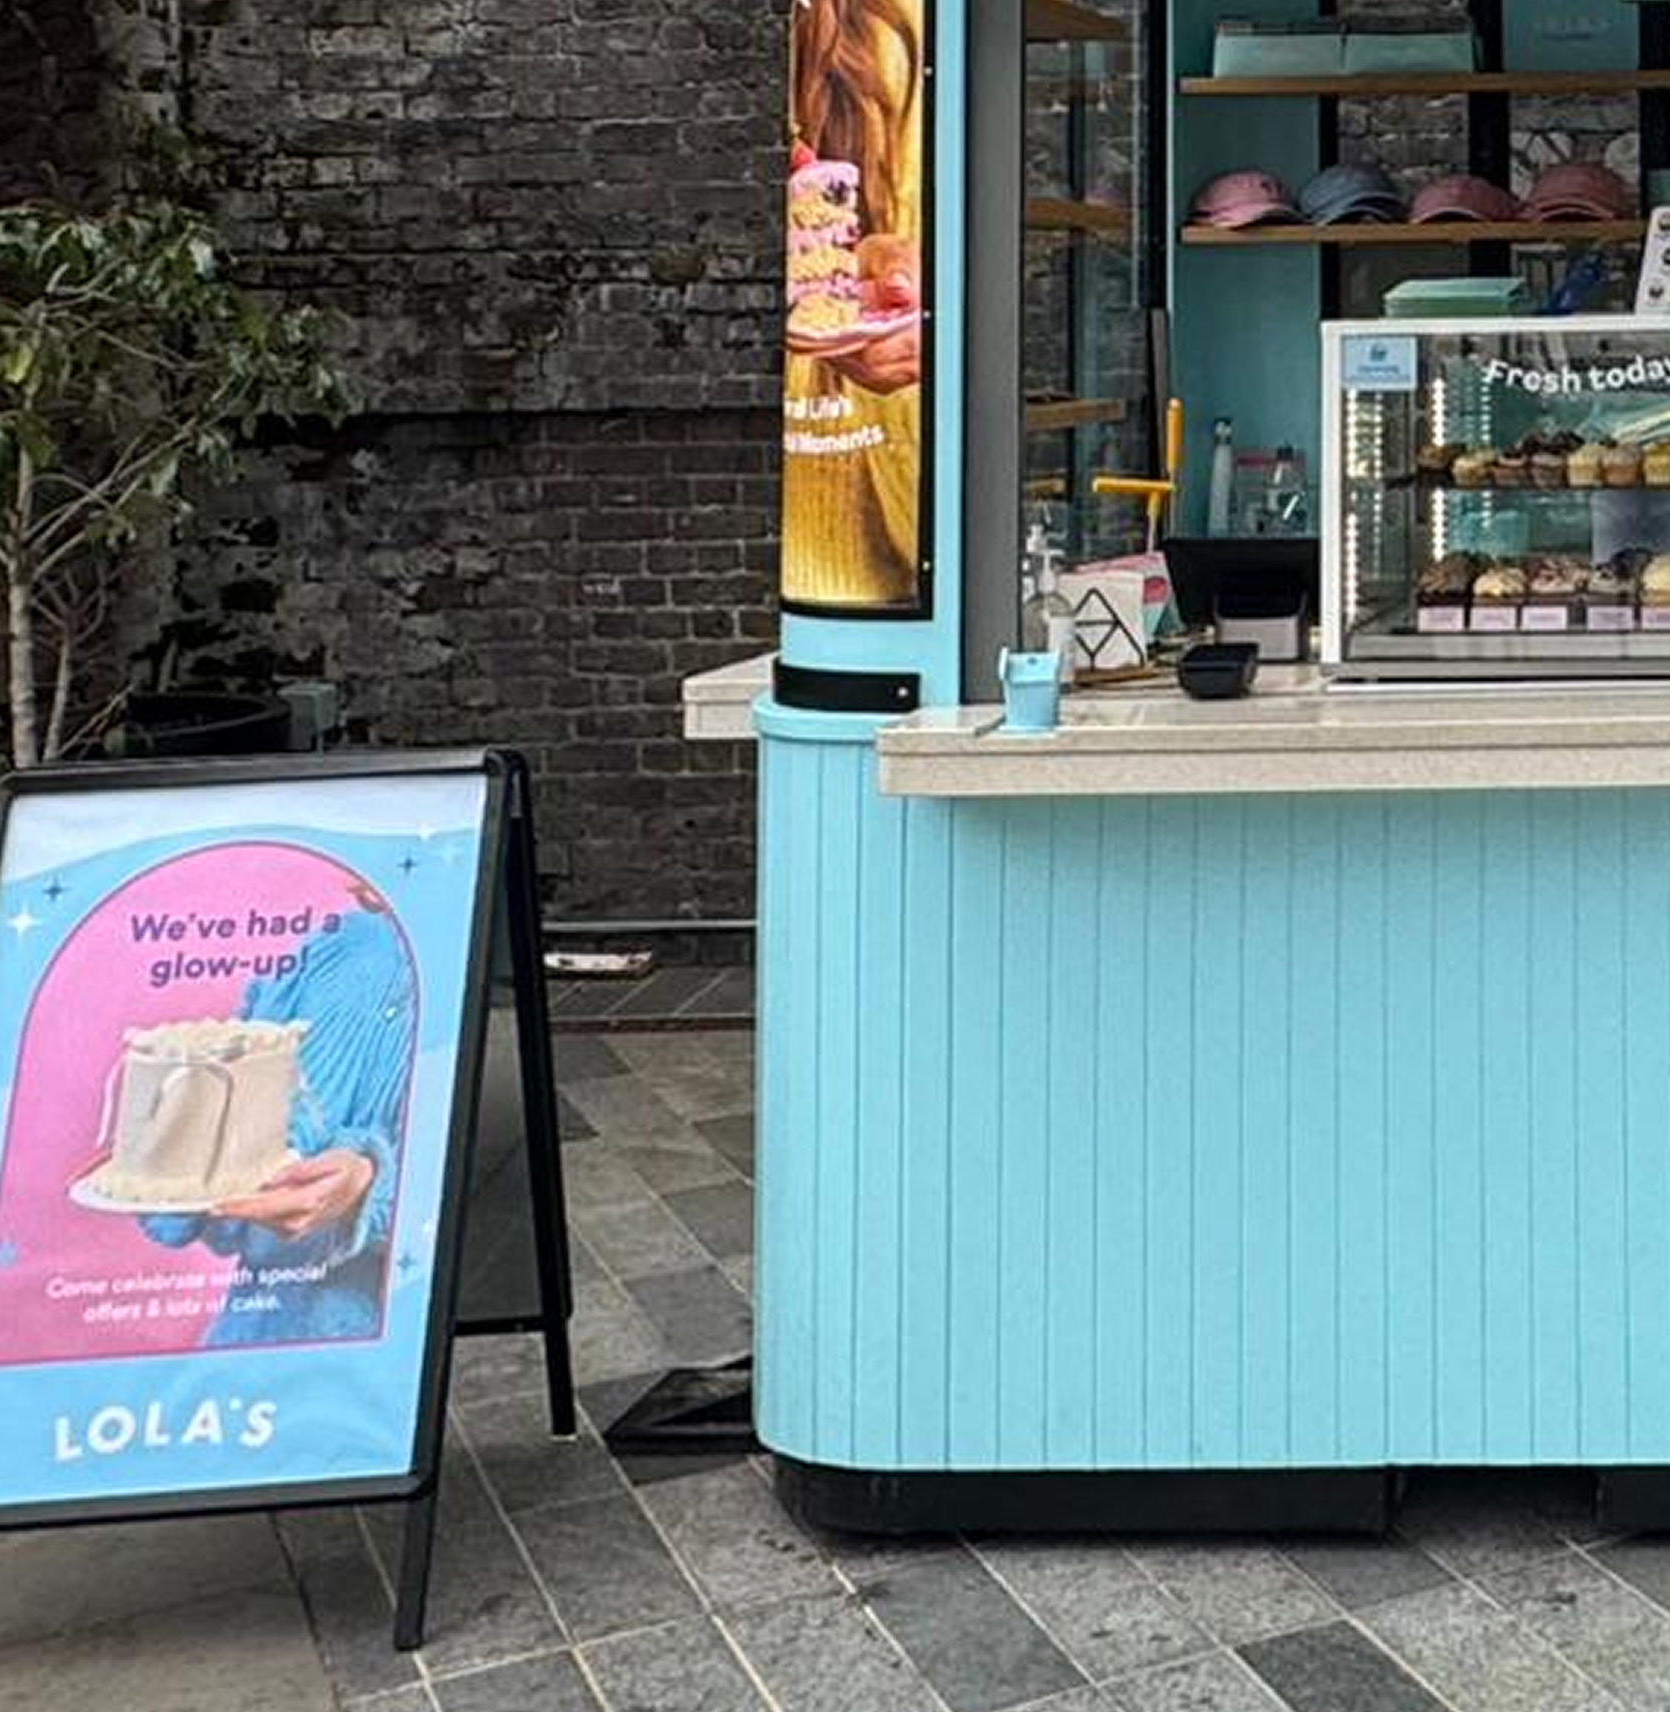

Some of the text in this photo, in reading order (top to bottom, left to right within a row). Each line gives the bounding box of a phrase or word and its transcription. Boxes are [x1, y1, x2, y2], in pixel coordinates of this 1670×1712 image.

[1483, 357, 1580, 395] Fresh
[131, 907, 341, 942] We've had a
[150, 945, 309, 988] glow-up!
[46, 1262, 327, 1299] Come celebrate with special
[83, 1302, 140, 1322] offers
[147, 1298, 160, 1317] &
[167, 1298, 201, 1316] lots
[207, 1293, 227, 1314] of
